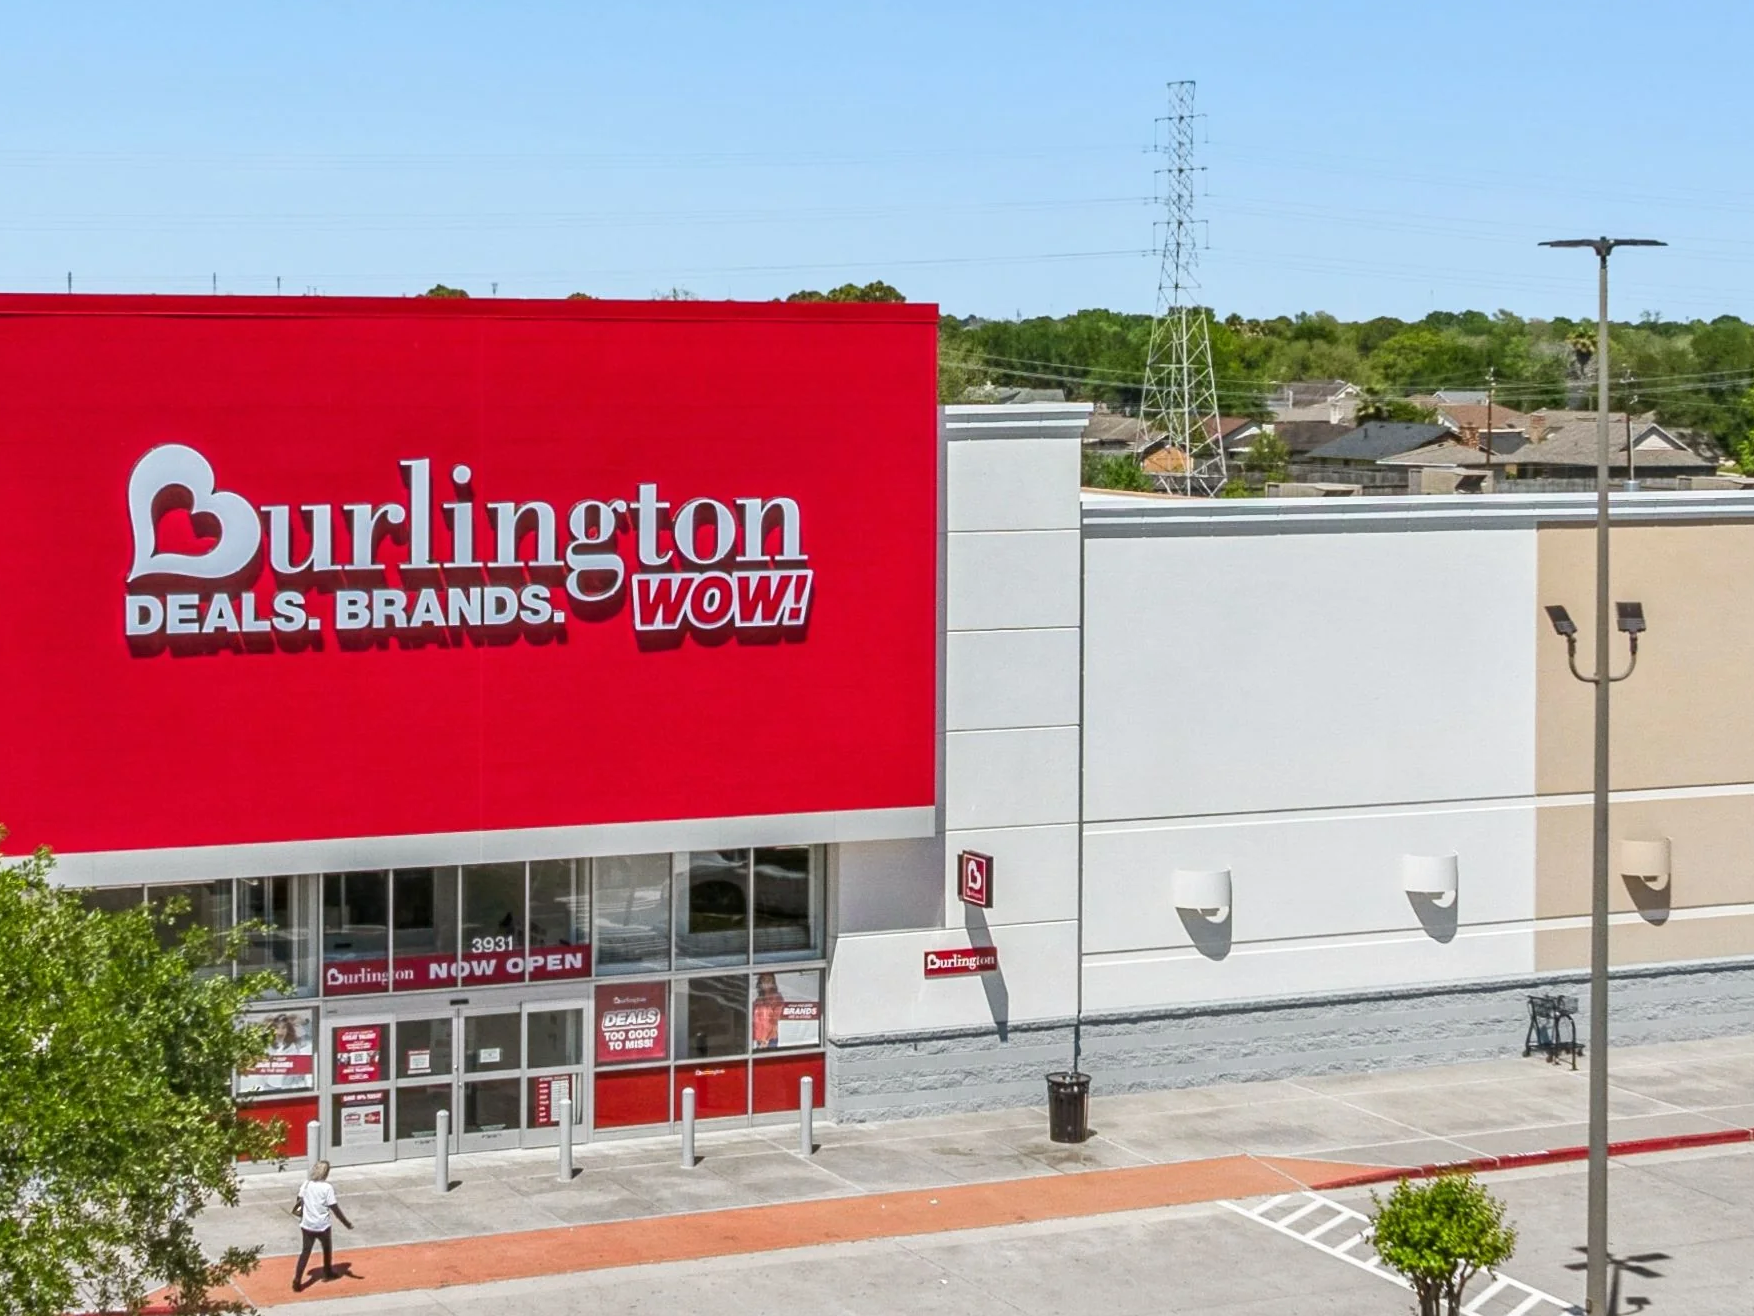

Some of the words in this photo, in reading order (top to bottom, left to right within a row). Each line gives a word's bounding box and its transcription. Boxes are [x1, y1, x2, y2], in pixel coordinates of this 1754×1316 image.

[126, 443, 809, 602] Burlington
[125, 587, 321, 636] DEALS.
[335, 582, 565, 631] BRANDS.
[631, 569, 813, 631] WOW!
[472, 936, 513, 953] 3931
[327, 967, 414, 985] Burlingon
[429, 959, 497, 979] NOW
[506, 953, 582, 973] OPEN
[926, 953, 995, 970] Burlington
[603, 1009, 658, 1028] DEALS
[604, 1031, 625, 1041] TOO
[628, 1029, 658, 1039] GOOD
[608, 1041, 623, 1051] TO
